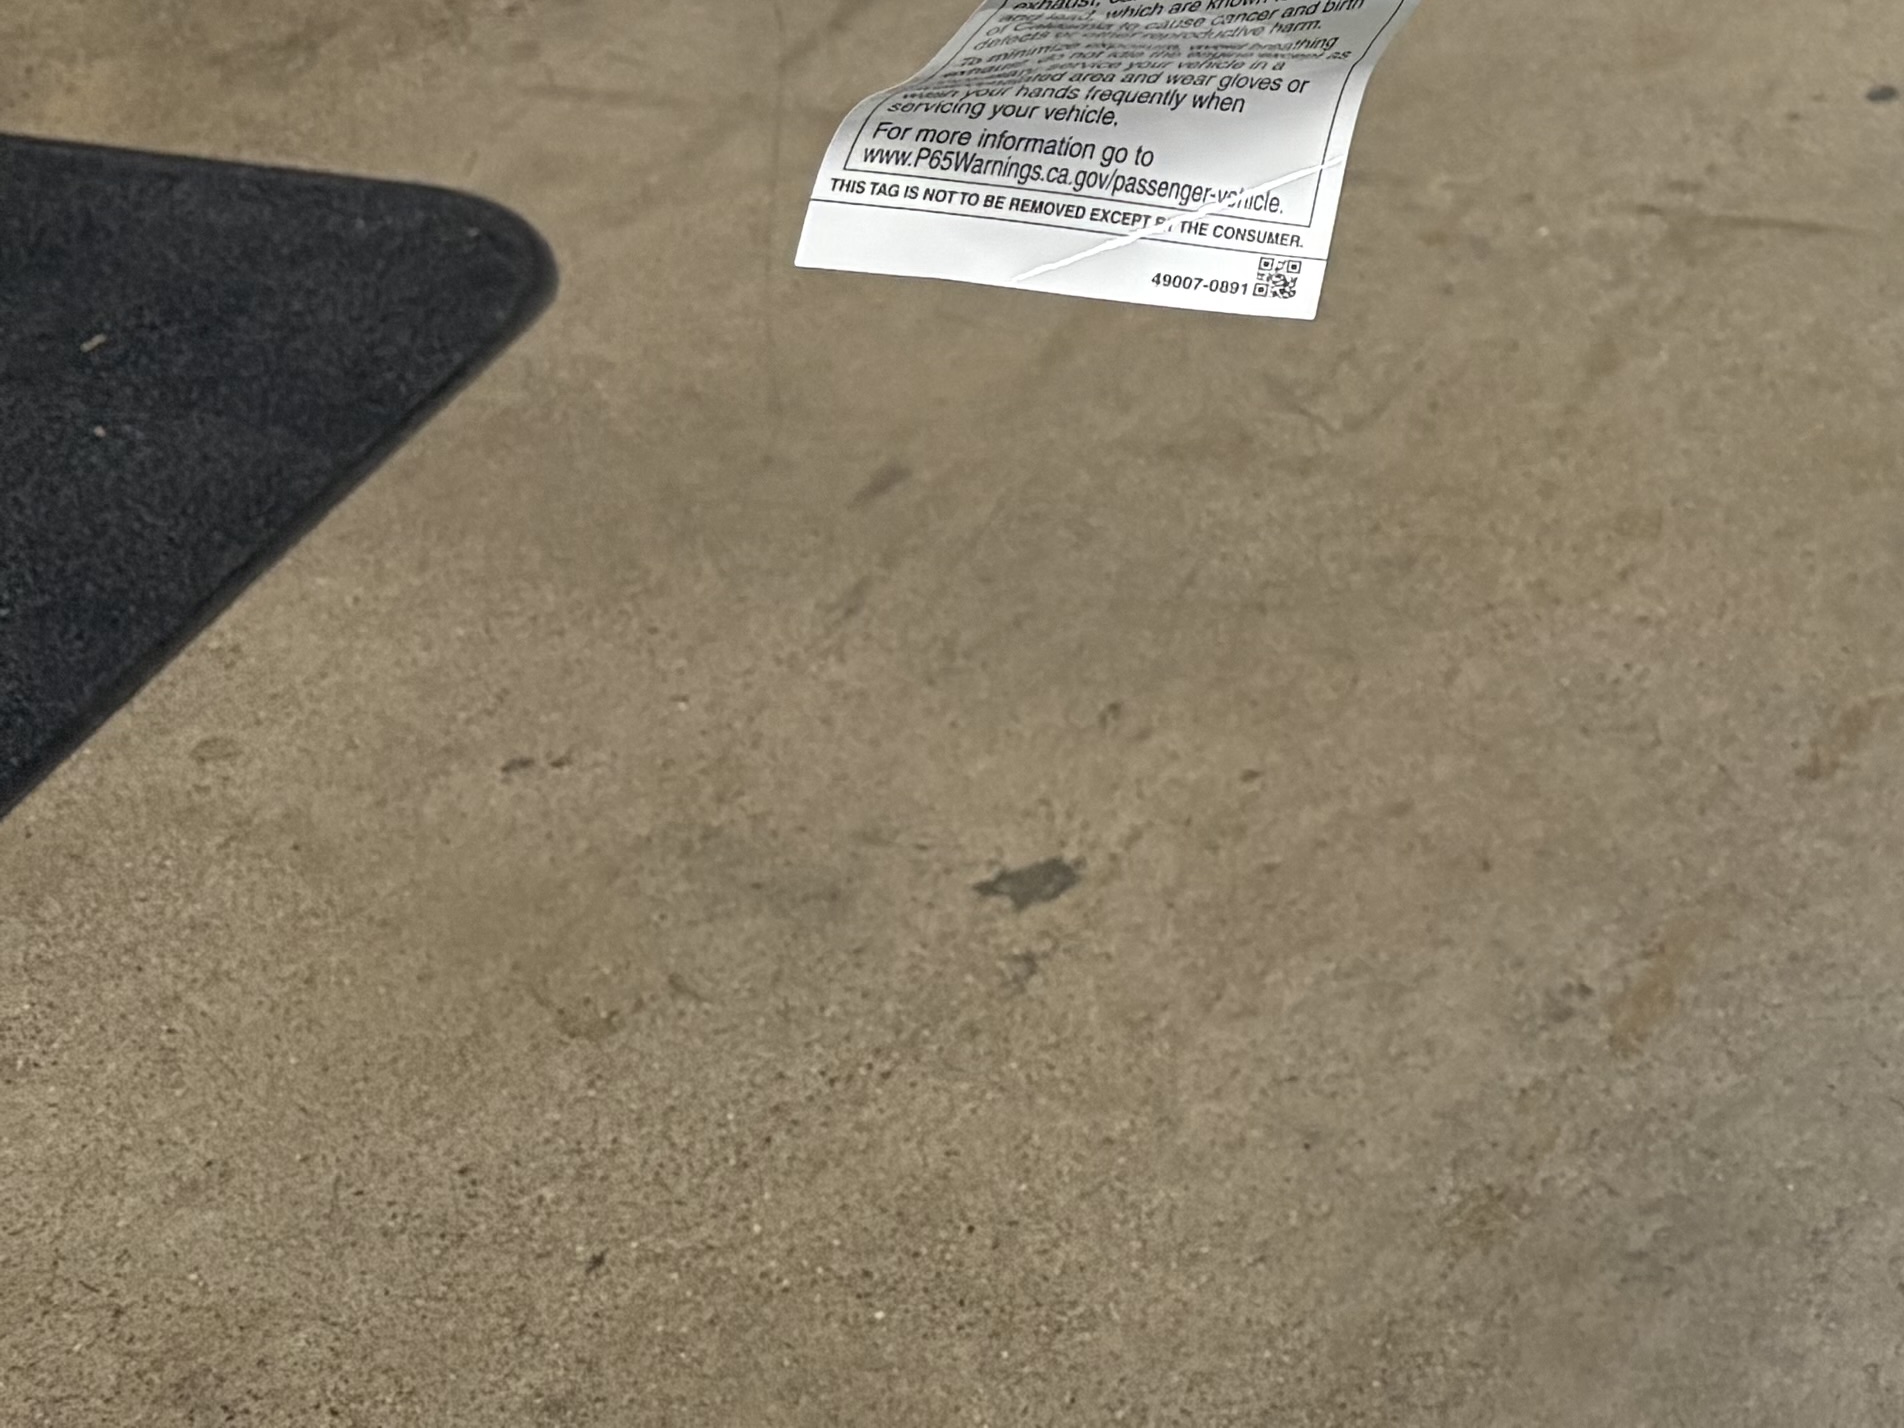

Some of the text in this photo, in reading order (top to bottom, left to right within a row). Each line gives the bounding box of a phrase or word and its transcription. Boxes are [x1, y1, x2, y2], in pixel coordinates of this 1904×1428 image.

[1105, 2, 1165, 19] which
[1168, 1, 1202, 15] are
[1211, 9, 1279, 26] cancer
[1281, 2, 1320, 19] and
[1269, 19, 1322, 35] harm.
[1069, 72, 1116, 83] area
[1120, 70, 1165, 84] and
[1167, 72, 1216, 87] wear
[1217, 72, 1283, 92] gloves
[1287, 79, 1311, 94] or
[959, 86, 1014, 101] your
[1015, 84, 1081, 100] hands
[1084, 85, 1188, 111] frequently
[1192, 92, 1246, 114] when
[887, 99, 1118, 127] servicing your vehicle.
[872, 121, 1154, 168] For more information go to
[831, 178, 865, 195] THIS
[869, 182, 900, 198] TAG
[904, 185, 919, 200] IS
[923, 188, 956, 204] NOT
[957, 191, 980, 207] TO
[983, 195, 1007, 210] BE
[1009, 198, 1087, 220] REMOVED
[1090, 207, 1152, 228] EXCEPT
[1180, 221, 1209, 236] THE
[1213, 225, 1304, 248] CONSUMER.
[1151, 273, 1249, 296] 49007-0891
